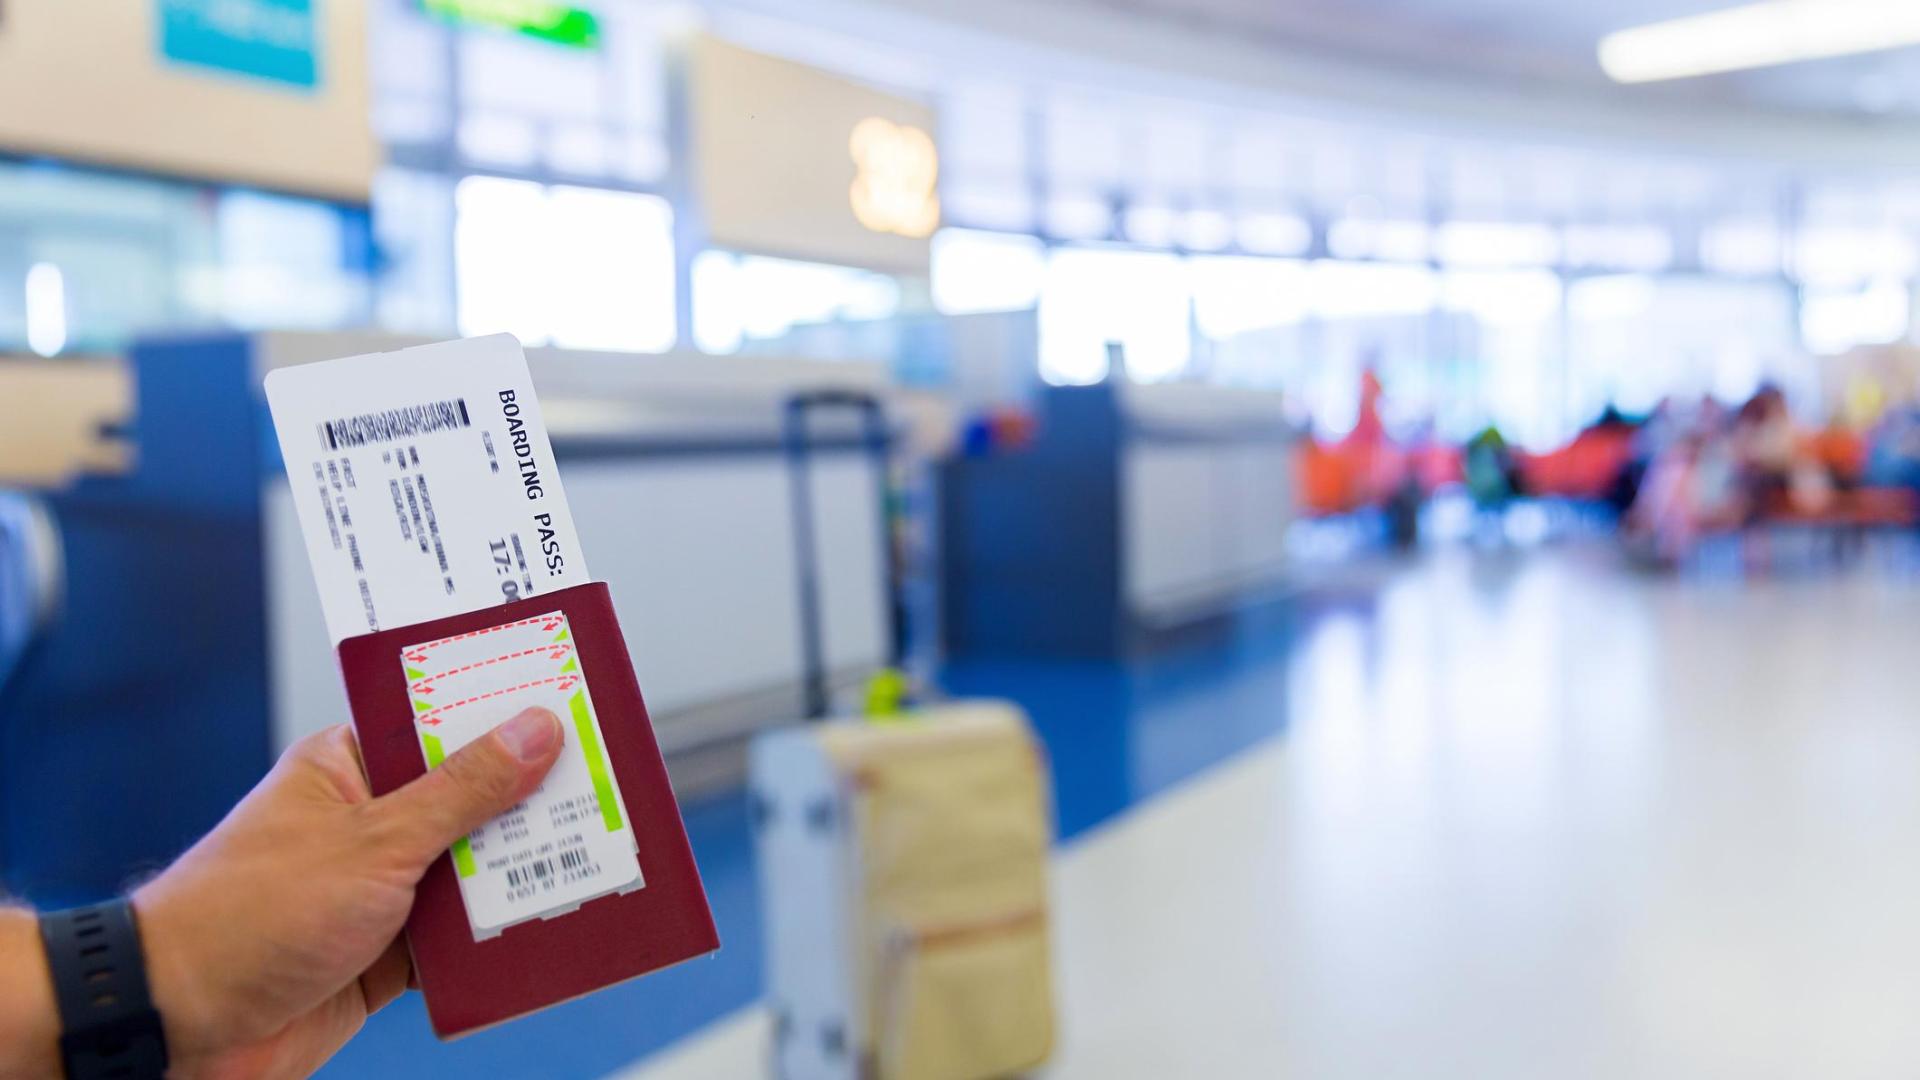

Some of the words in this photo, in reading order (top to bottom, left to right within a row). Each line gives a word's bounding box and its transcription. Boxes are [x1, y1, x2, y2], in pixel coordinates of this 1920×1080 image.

[325, 459, 342, 492] HELP
[335, 495, 351, 526] LINE
[344, 532, 364, 573] PHONE
[498, 389, 544, 501] BOARDING
[534, 513, 564, 576] PASS:
